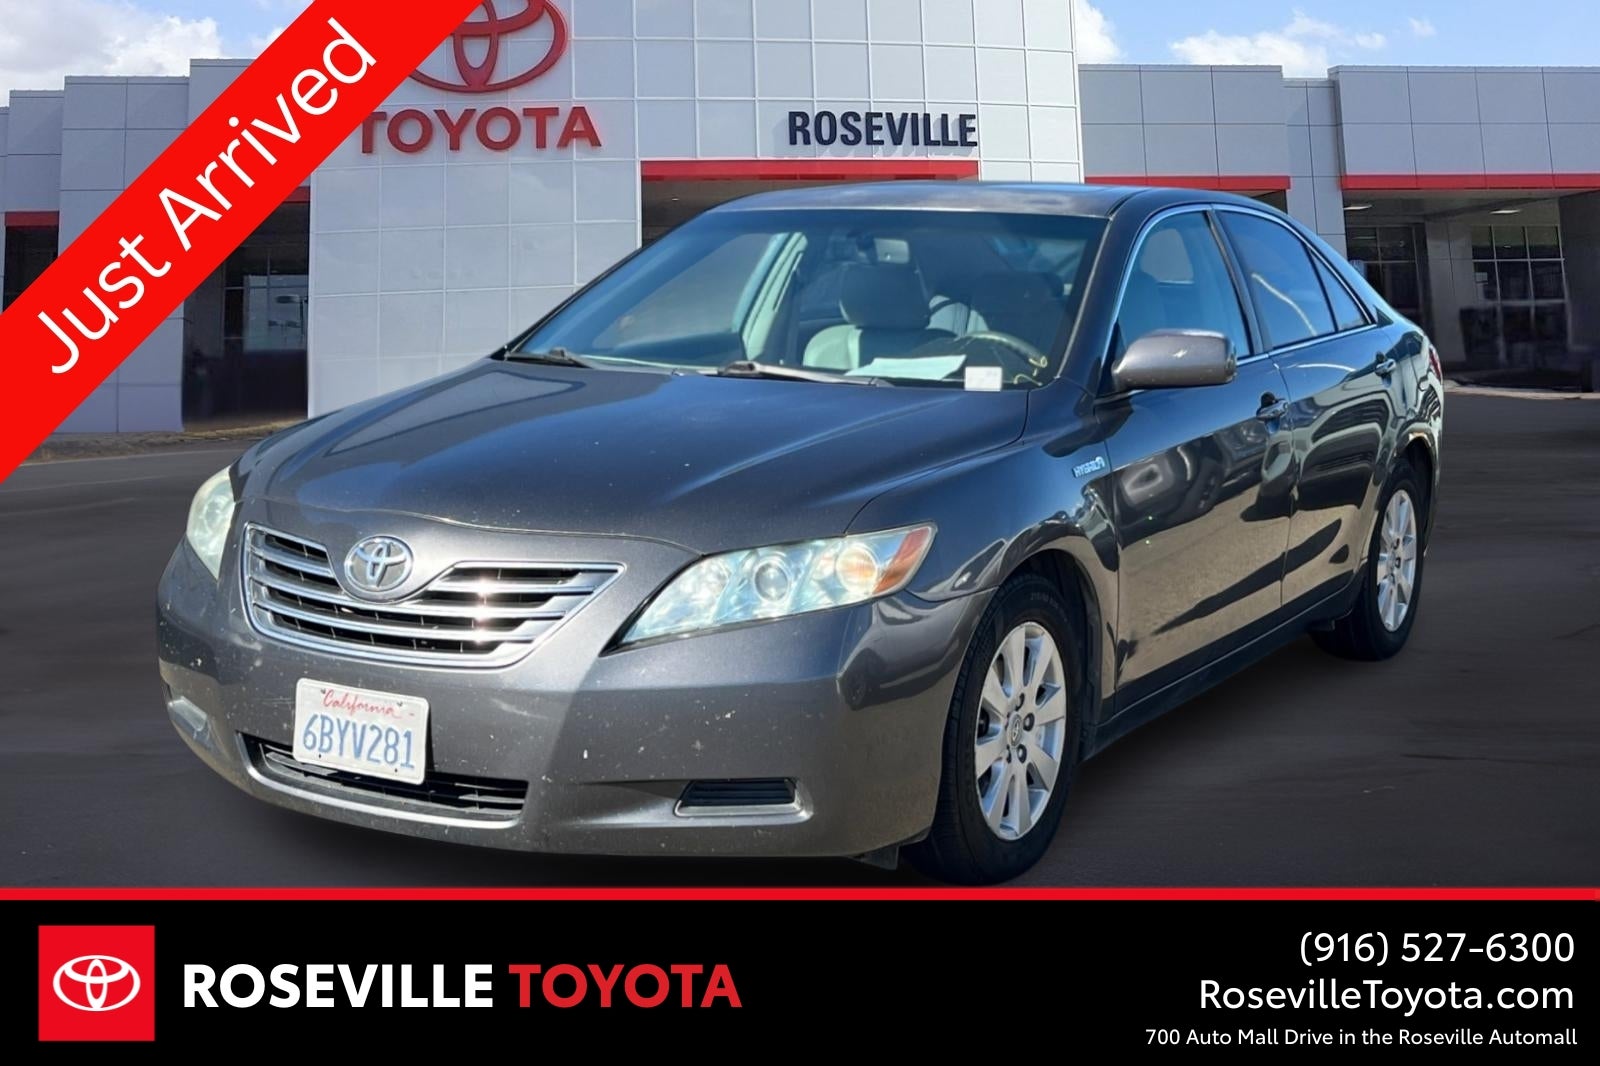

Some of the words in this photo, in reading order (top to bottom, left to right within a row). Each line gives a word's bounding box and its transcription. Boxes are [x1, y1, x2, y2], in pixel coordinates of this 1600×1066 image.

[361, 106, 602, 153] TOYOTA
[788, 111, 978, 147] ROSEVILLE
[323, 688, 402, 719] California
[303, 713, 414, 769] 6BYV281
